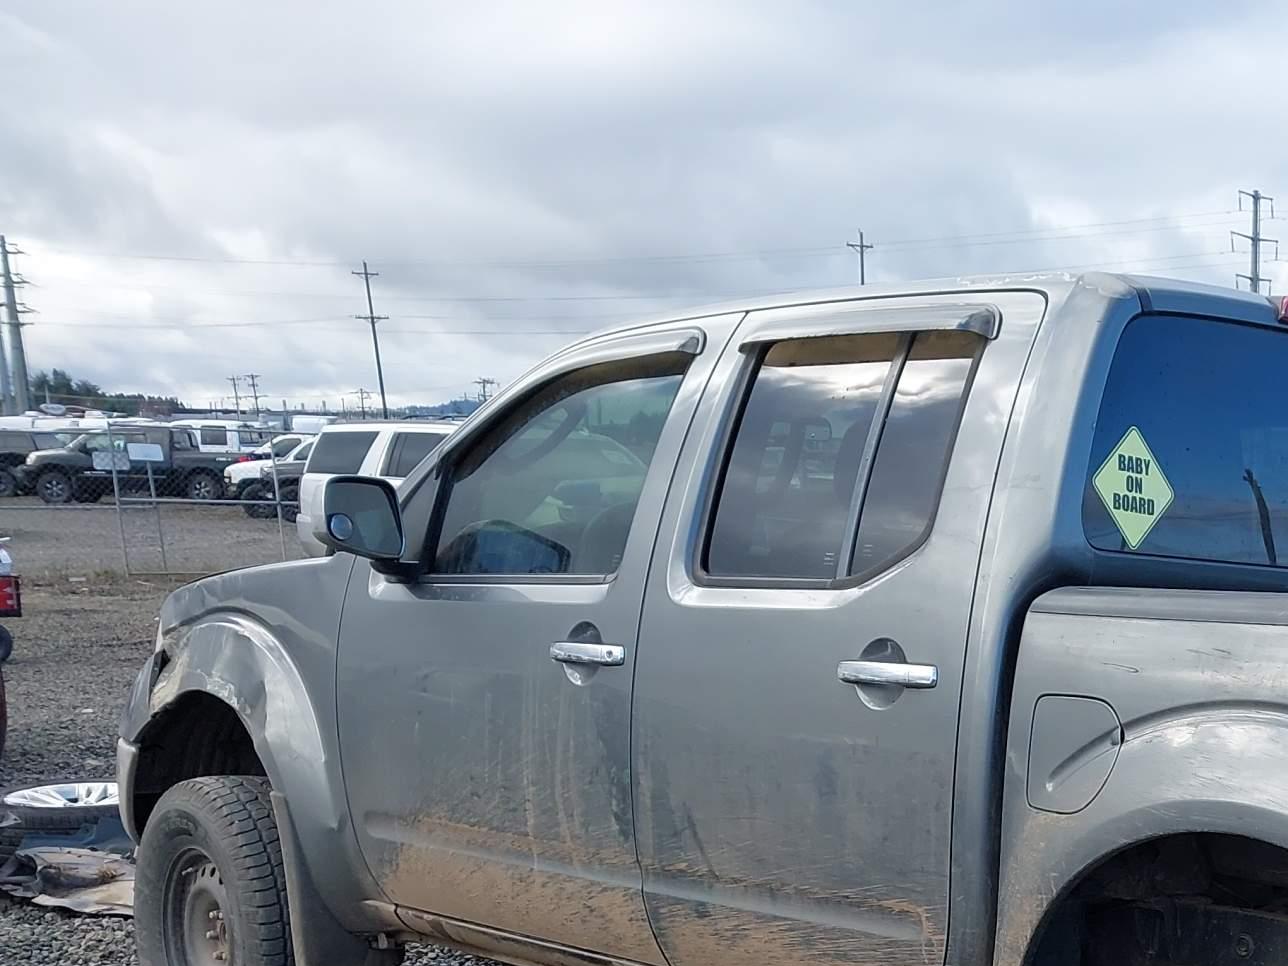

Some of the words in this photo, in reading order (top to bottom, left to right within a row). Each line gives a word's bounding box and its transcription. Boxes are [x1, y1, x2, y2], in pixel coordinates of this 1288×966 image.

[1118, 453, 1151, 476] BABY
[1126, 475, 1143, 494] ON
[1113, 492, 1155, 516] BOARD
